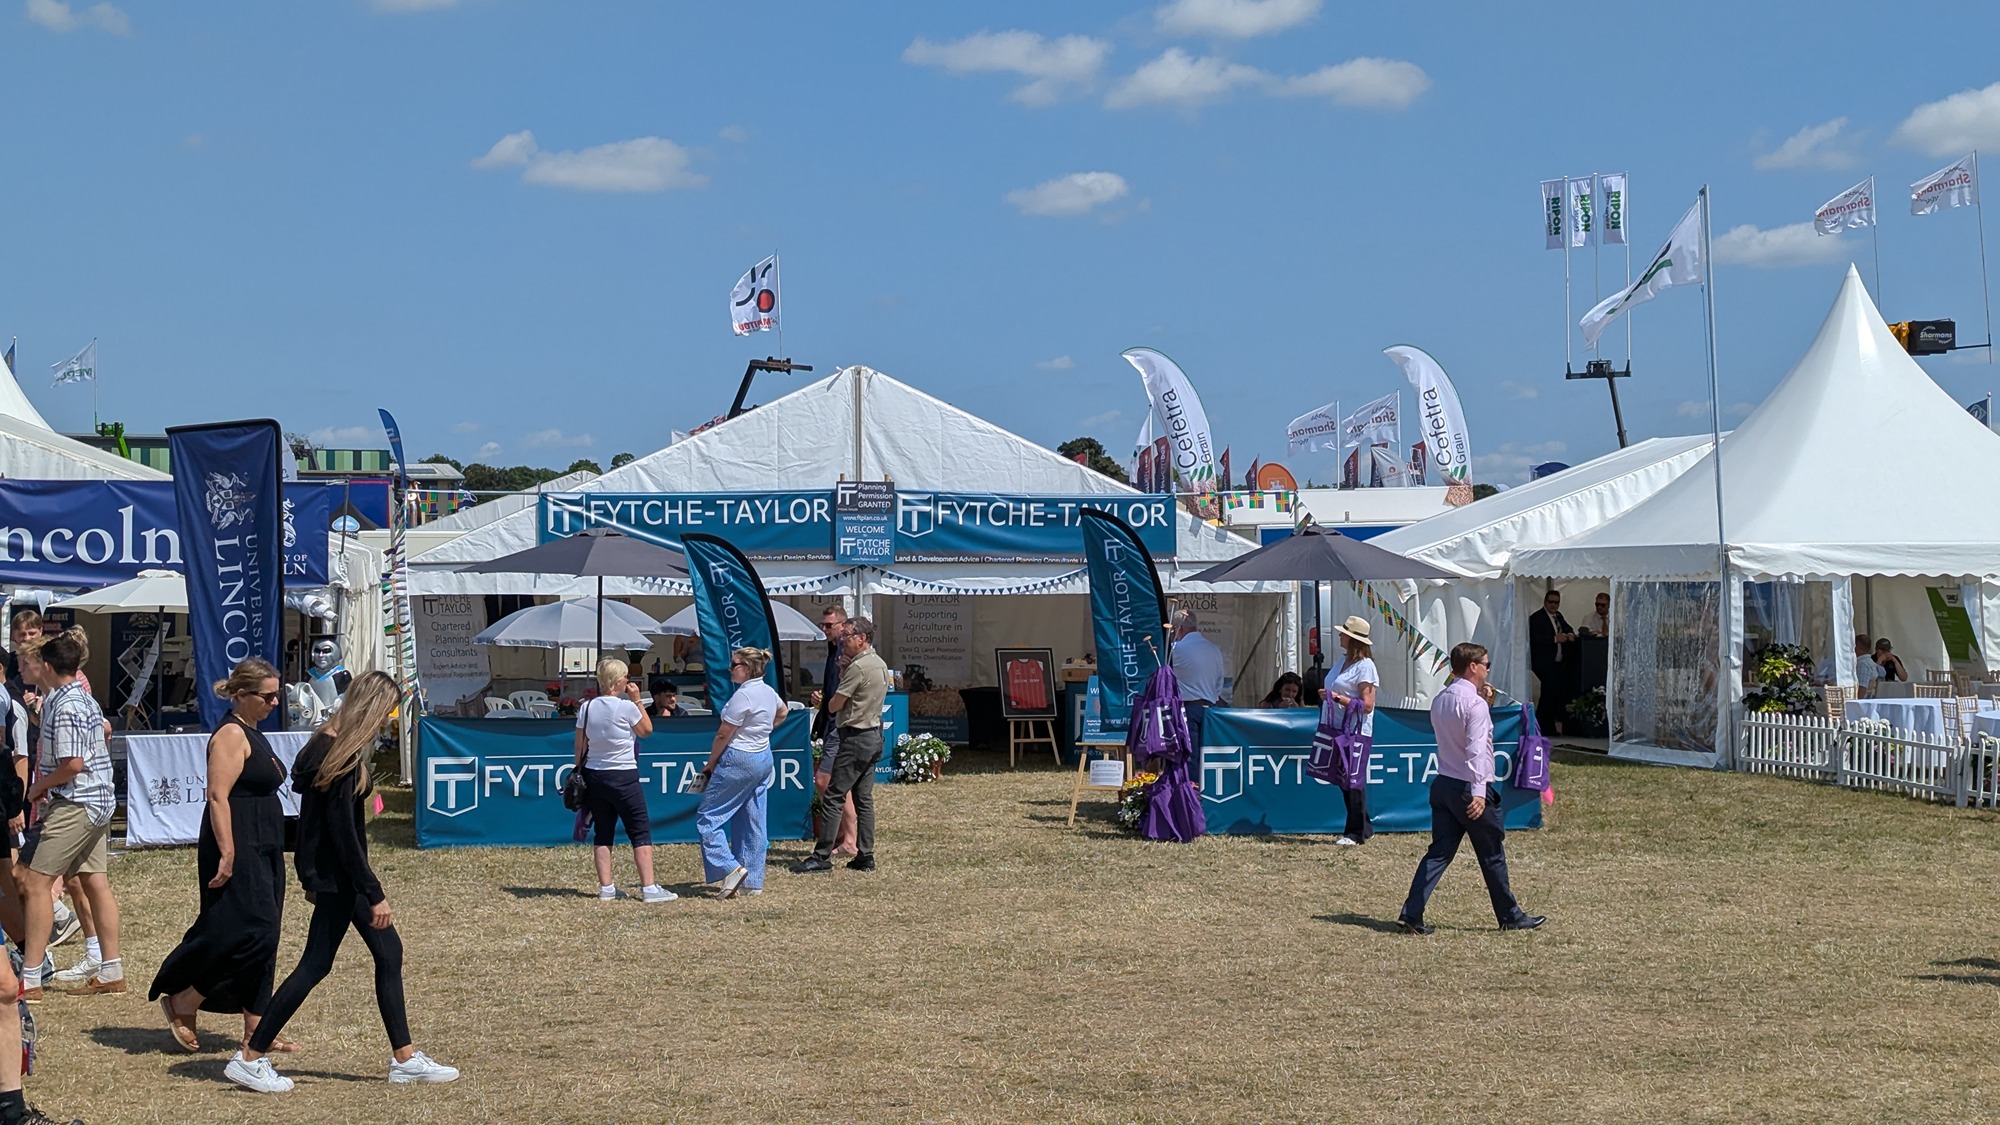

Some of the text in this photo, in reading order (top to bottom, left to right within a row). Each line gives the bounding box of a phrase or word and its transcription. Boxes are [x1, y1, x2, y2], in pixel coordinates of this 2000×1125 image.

[1580, 194, 1590, 232] RIPON
[1610, 191, 1621, 229] RIPON
[1551, 197, 1561, 235] RIPON
[1920, 331, 1952, 339] Sharmans
[1161, 387, 1197, 470] Cefetra
[1422, 386, 1453, 467] Cefetra
[1199, 431, 1212, 464] Grain
[1455, 432, 1466, 464] Grain
[858, 483, 887, 492] Planning
[858, 492, 894, 500] Permission
[590, 498, 832, 525] FYTCHE-TAYLOR
[857, 539, 890, 547] FYTCHE
[857, 547, 890, 556] TAYLOR
[918, 555, 958, 563] Development
[214, 535, 250, 663] LINCO
[245, 534, 263, 658] UNIVERSIT
[924, 595, 960, 603] TAYLOR
[440, 603, 473, 613] TAYLOR
[1178, 600, 1218, 610] TAYLOR
[908, 610, 958, 621] Supporting
[431, 621, 471, 631] Chartered
[903, 622, 963, 633] Agriculture in
[435, 635, 470, 646] Planning
[906, 634, 959, 644] Lincolnshire
[1114, 570, 1144, 707] FYTCHE-TAYLOR
[430, 648, 478, 658] Consultants
[1249, 751, 1512, 785] FYTE-TAO
[485, 758, 805, 798] FYTC-TAR
